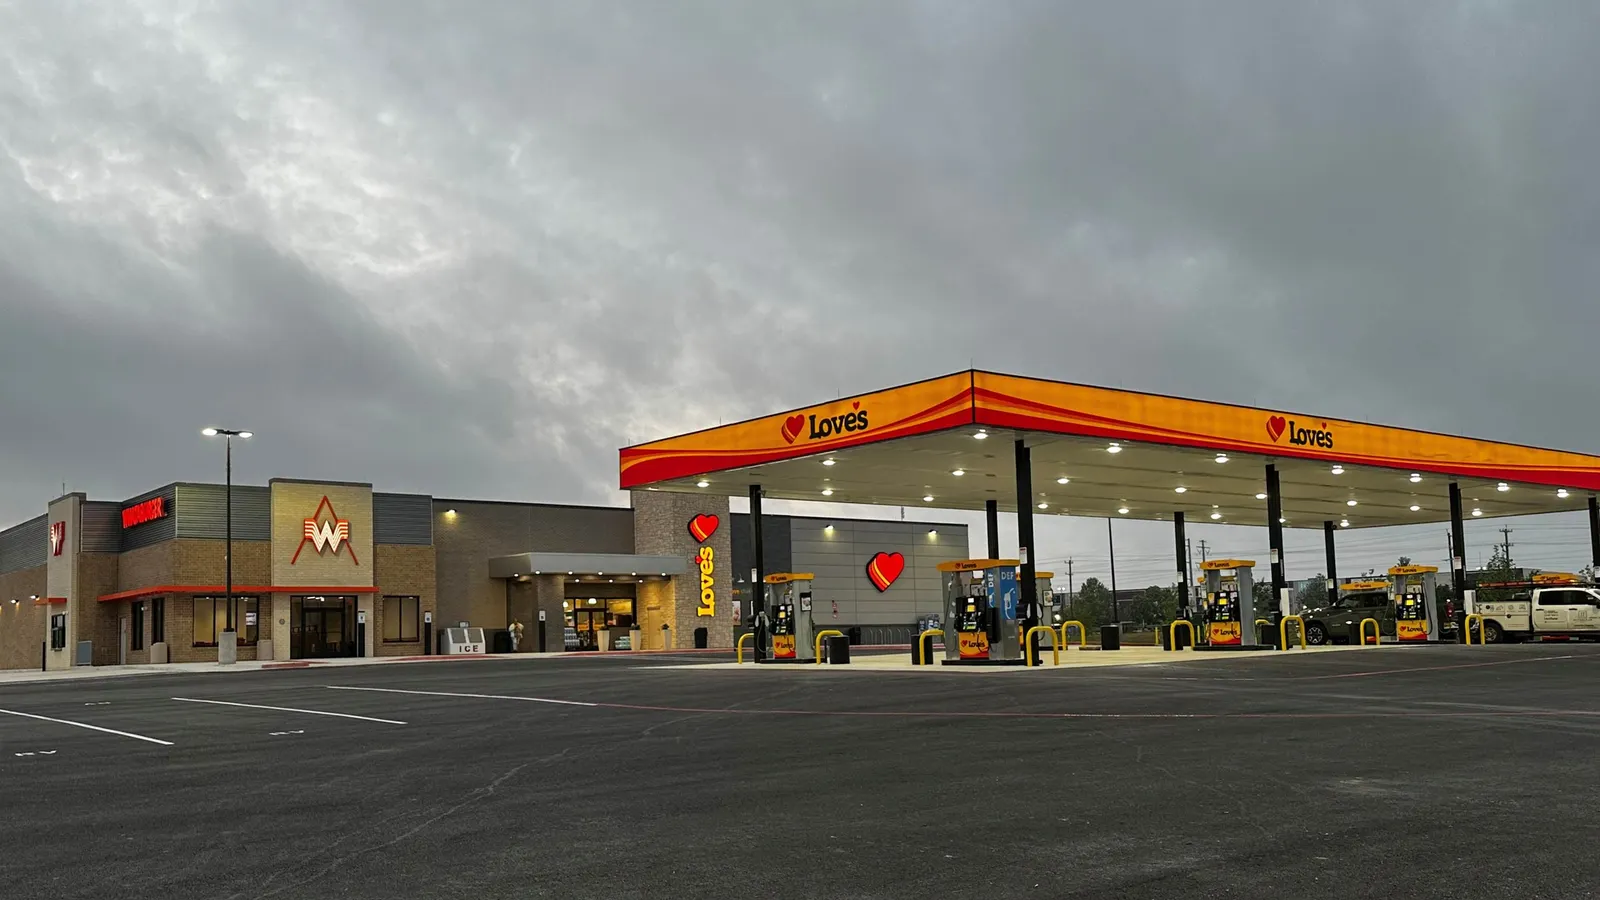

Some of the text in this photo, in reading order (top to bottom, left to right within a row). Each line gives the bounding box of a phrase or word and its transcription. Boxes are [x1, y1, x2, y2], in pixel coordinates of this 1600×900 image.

[809, 401, 869, 439] Love's
[1289, 421, 1333, 449] Love's
[695, 546, 715, 617] Love's
[1001, 571, 1014, 580] DEF
[459, 644, 479, 653] ICE
